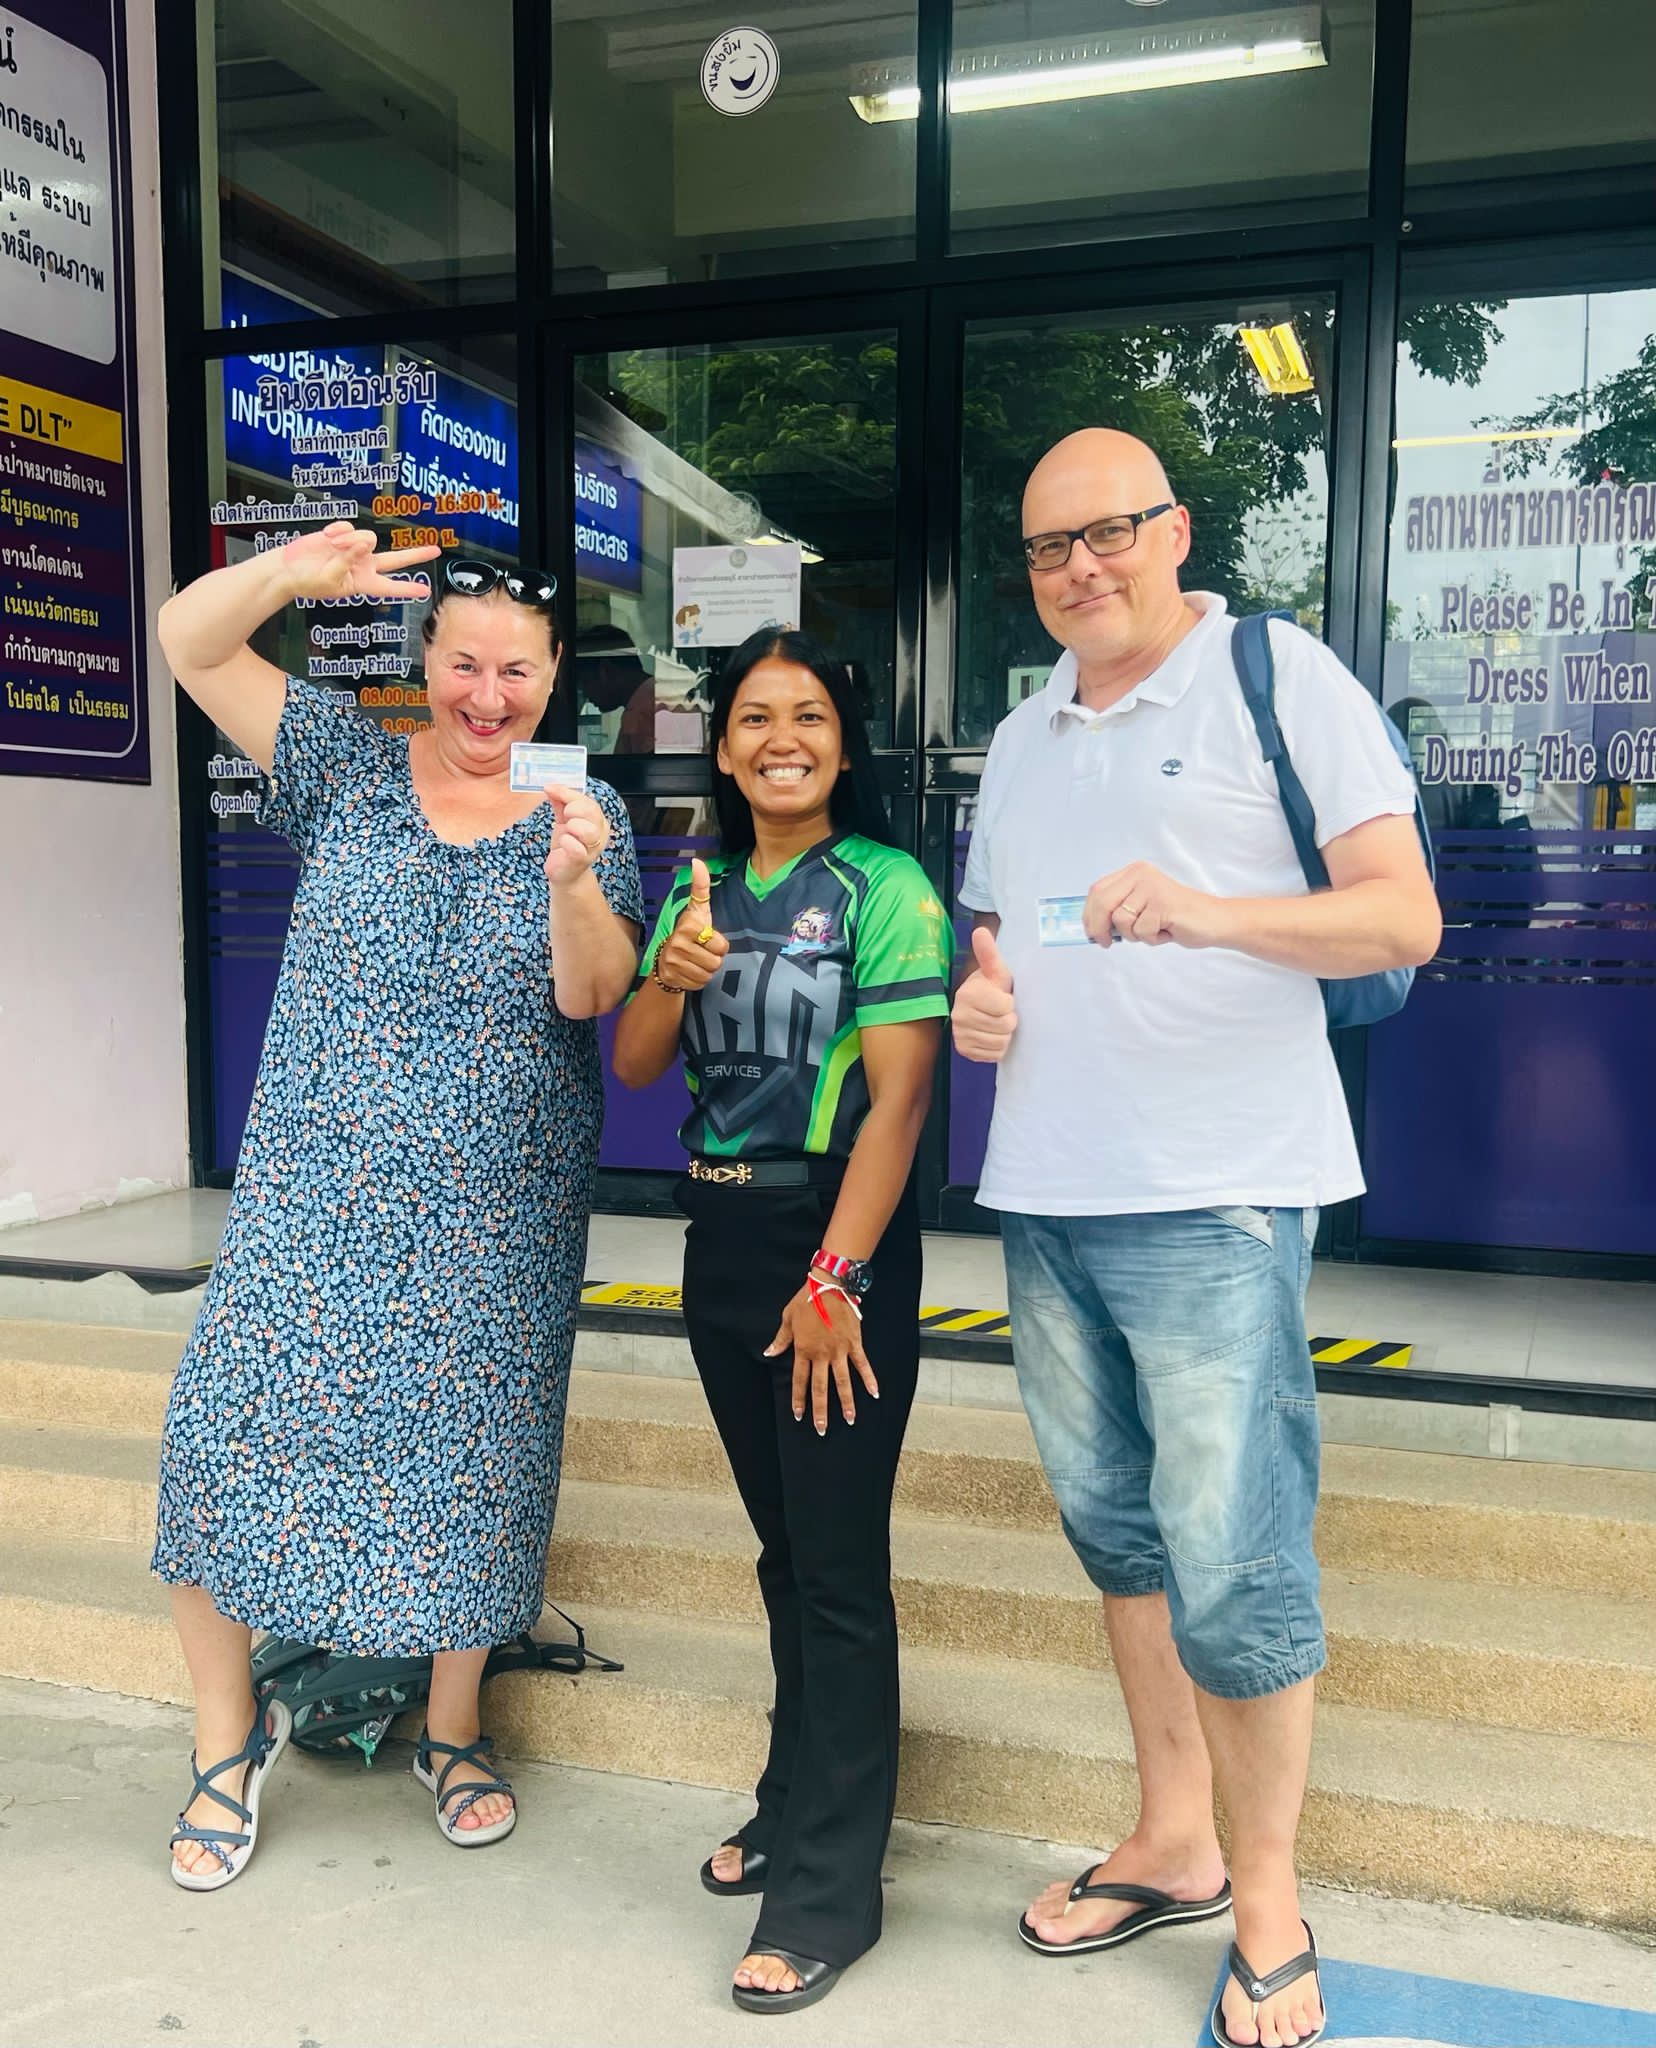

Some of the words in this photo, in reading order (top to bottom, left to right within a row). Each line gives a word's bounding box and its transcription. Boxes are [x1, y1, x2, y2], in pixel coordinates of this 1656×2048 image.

[0, 167, 31, 201] แล
[42, 186, 91, 227] ระบบ
[0, 211, 105, 292] ห้มีคุณภาพ
[257, 363, 436, 411] ยินดีต้อนรับ
[291, 425, 389, 454] เวลาทำการปกติ
[421, 401, 506, 467] คัดกรองงาน
[1, 488, 79, 529] มีบูรณาการ
[210, 493, 358, 525] เปิดให้บริการตั้งแต่เวลา
[373, 495, 420, 515] 08.00
[435, 492, 482, 514] 16.30
[392, 528, 439, 549] 15.30
[2, 544, 84, 579] งานโดดเด่น
[4, 581, 100, 627] เน้นนวัตกรรม
[1440, 585, 1533, 634] Please
[1546, 582, 1585, 630] Be
[1600, 580, 1633, 630] In
[4, 633, 120, 675] กำกับตามกฎหมาย
[311, 623, 369, 649] Opening
[371, 622, 408, 645] Time
[308, 654, 412, 680] Monday-Friday
[1467, 657, 1549, 704] Dress
[1564, 650, 1649, 704] When
[5, 679, 60, 713] โปร่งใส
[68, 690, 129, 720] เป็นธรรม
[360, 687, 403, 707] 08.00
[1424, 733, 1526, 797] During
[1538, 730, 1596, 783] The
[211, 791, 241, 818] Open
